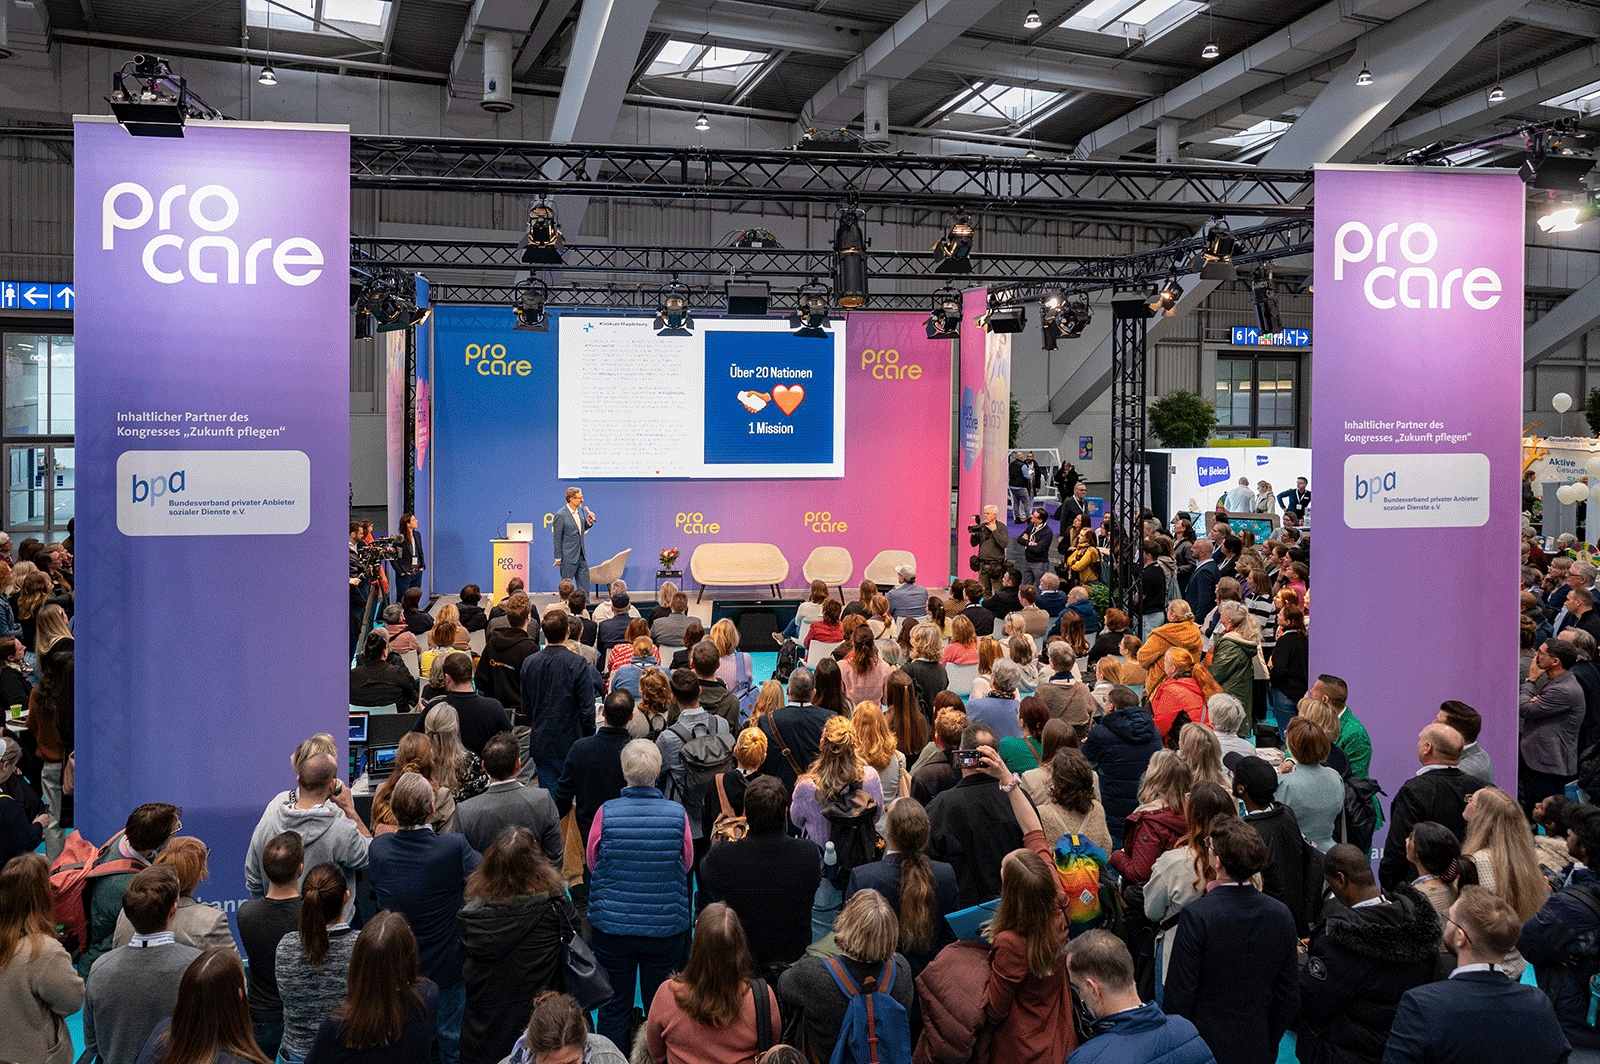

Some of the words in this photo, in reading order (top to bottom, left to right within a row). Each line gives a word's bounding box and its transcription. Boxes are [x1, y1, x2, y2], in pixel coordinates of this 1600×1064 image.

[102, 181, 240, 250] pro
[1334, 221, 1438, 281] pro
[142, 234, 325, 287] care
[1363, 266, 1503, 311] care
[1236, 331, 1243, 341] 6
[465, 343, 507, 366] pro
[861, 349, 900, 370] pro
[477, 359, 532, 376] care
[729, 363, 755, 378] Über
[756, 366, 769, 378] 20
[770, 366, 813, 378] Nationen
[871, 363, 923, 380] care
[117, 411, 182, 422] Inhaltlicher
[185, 411, 227, 422] Partner
[229, 411, 249, 422] des
[963, 405, 974, 420] pro
[748, 422, 755, 434] 1
[756, 422, 794, 434] Mission
[964, 417, 979, 430] care
[1344, 420, 1395, 430] Inhaltlicher
[1396, 420, 1428, 430] Partner
[1429, 420, 1444, 430] des
[117, 426, 181, 439] Kongresses
[1344, 433, 1393, 445] Kongresses
[1549, 458, 1576, 466] Aktive
[1199, 467, 1208, 476] De
[1209, 466, 1229, 476] Beleef
[132, 470, 185, 507] bpa
[1355, 471, 1396, 503] bpa
[231, 499, 261, 508] privater
[201, 508, 230, 516] Dienste
[804, 511, 832, 527] pro
[675, 512, 704, 528] pro
[811, 521, 848, 533] care
[683, 522, 721, 535] care
[497, 557, 514, 567] pro
